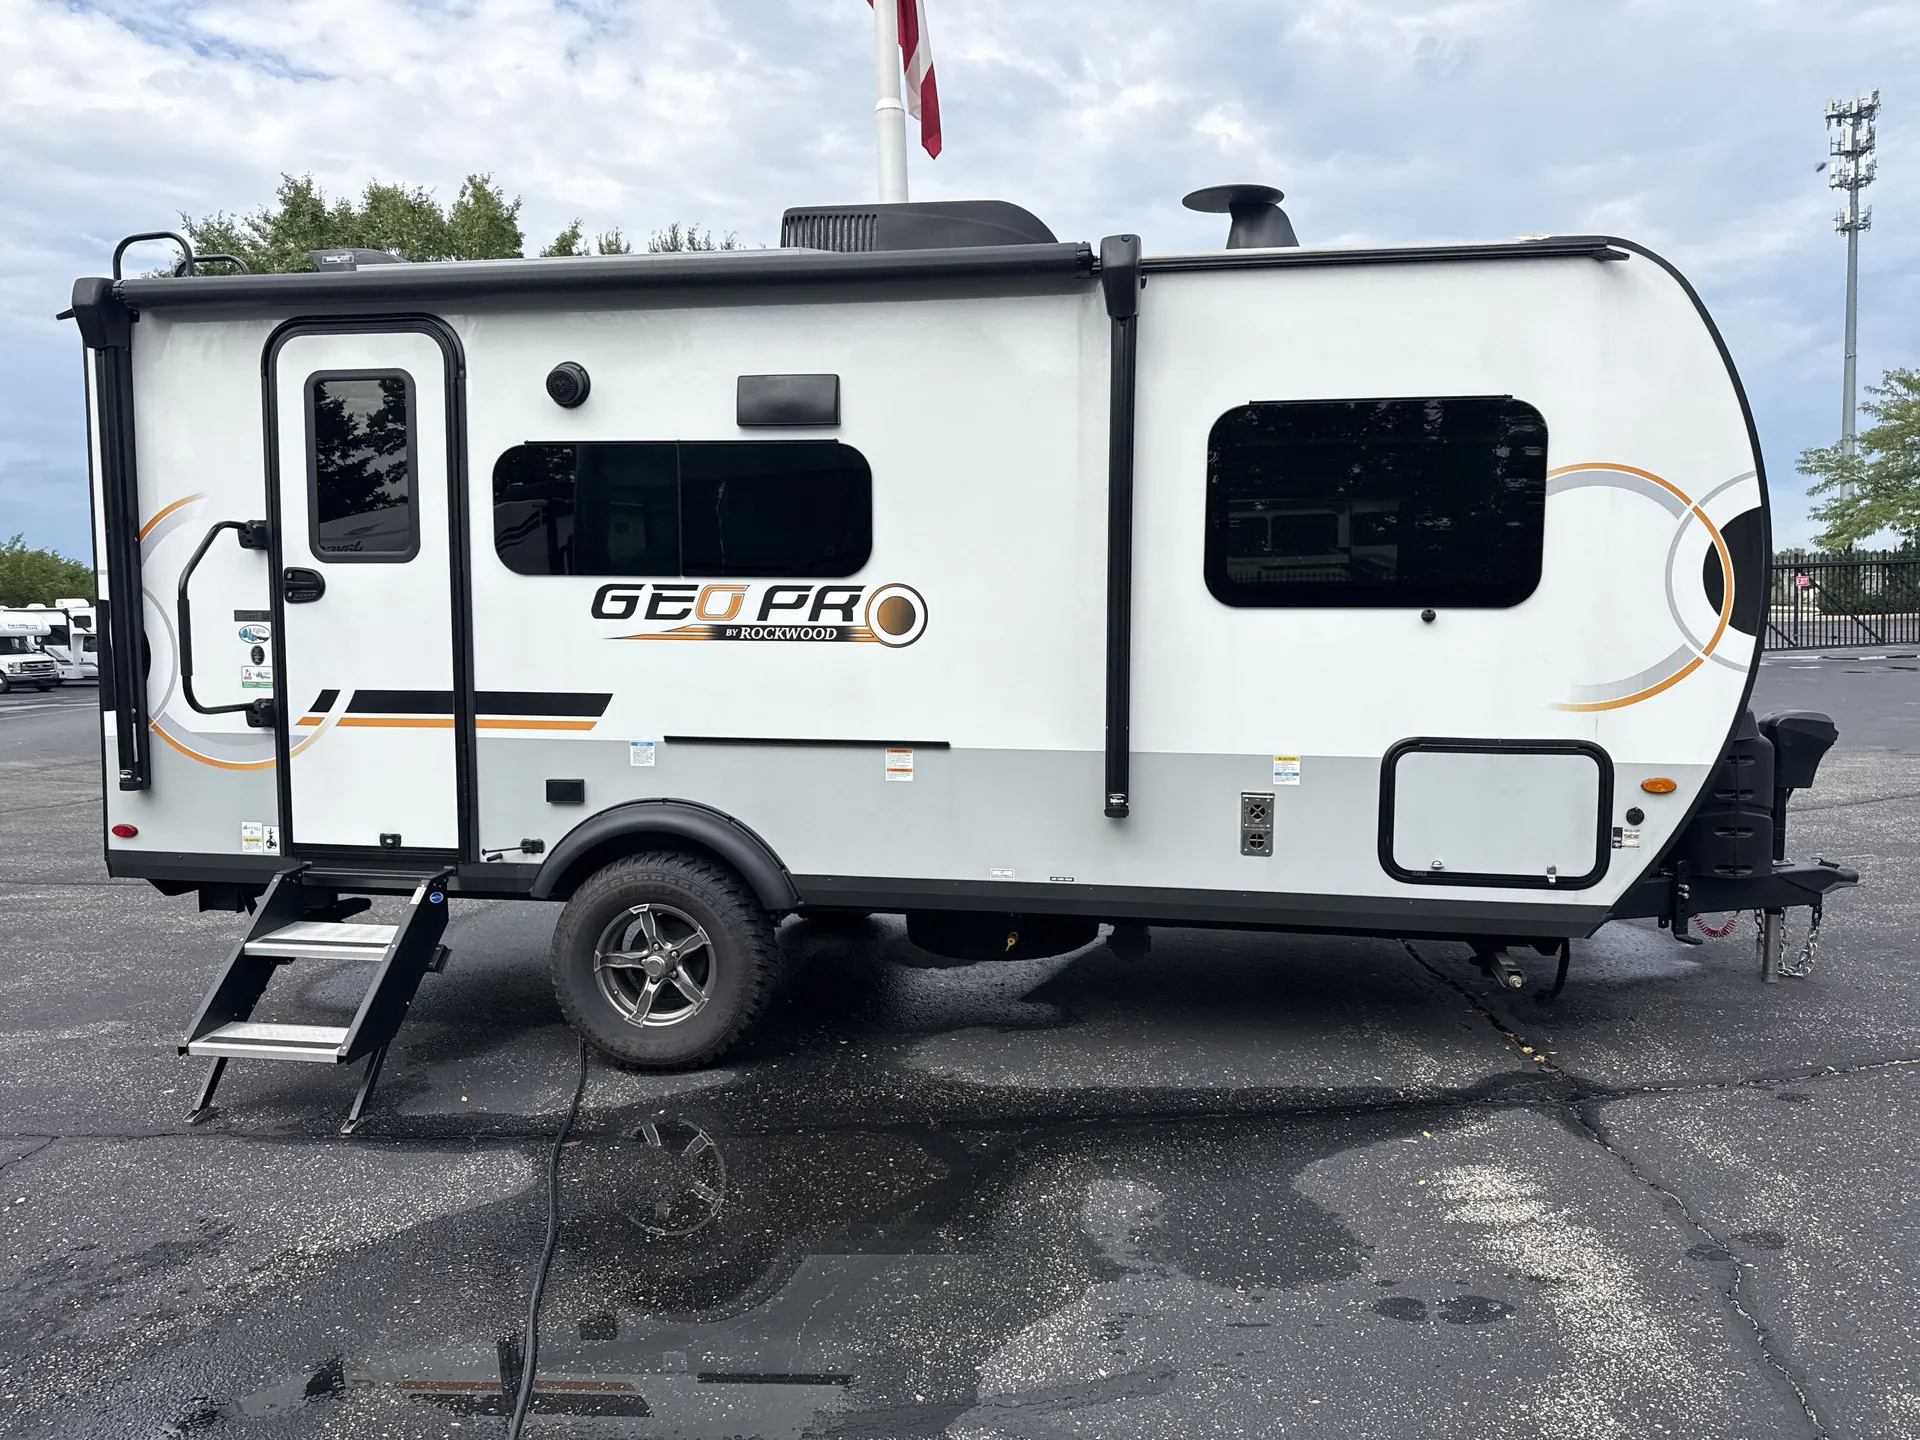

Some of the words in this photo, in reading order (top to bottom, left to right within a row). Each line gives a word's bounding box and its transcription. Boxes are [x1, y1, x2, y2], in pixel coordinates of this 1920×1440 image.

[590, 583, 751, 622] GEO
[725, 628, 738, 637] BY
[739, 626, 837, 641] ROCKWOOD
